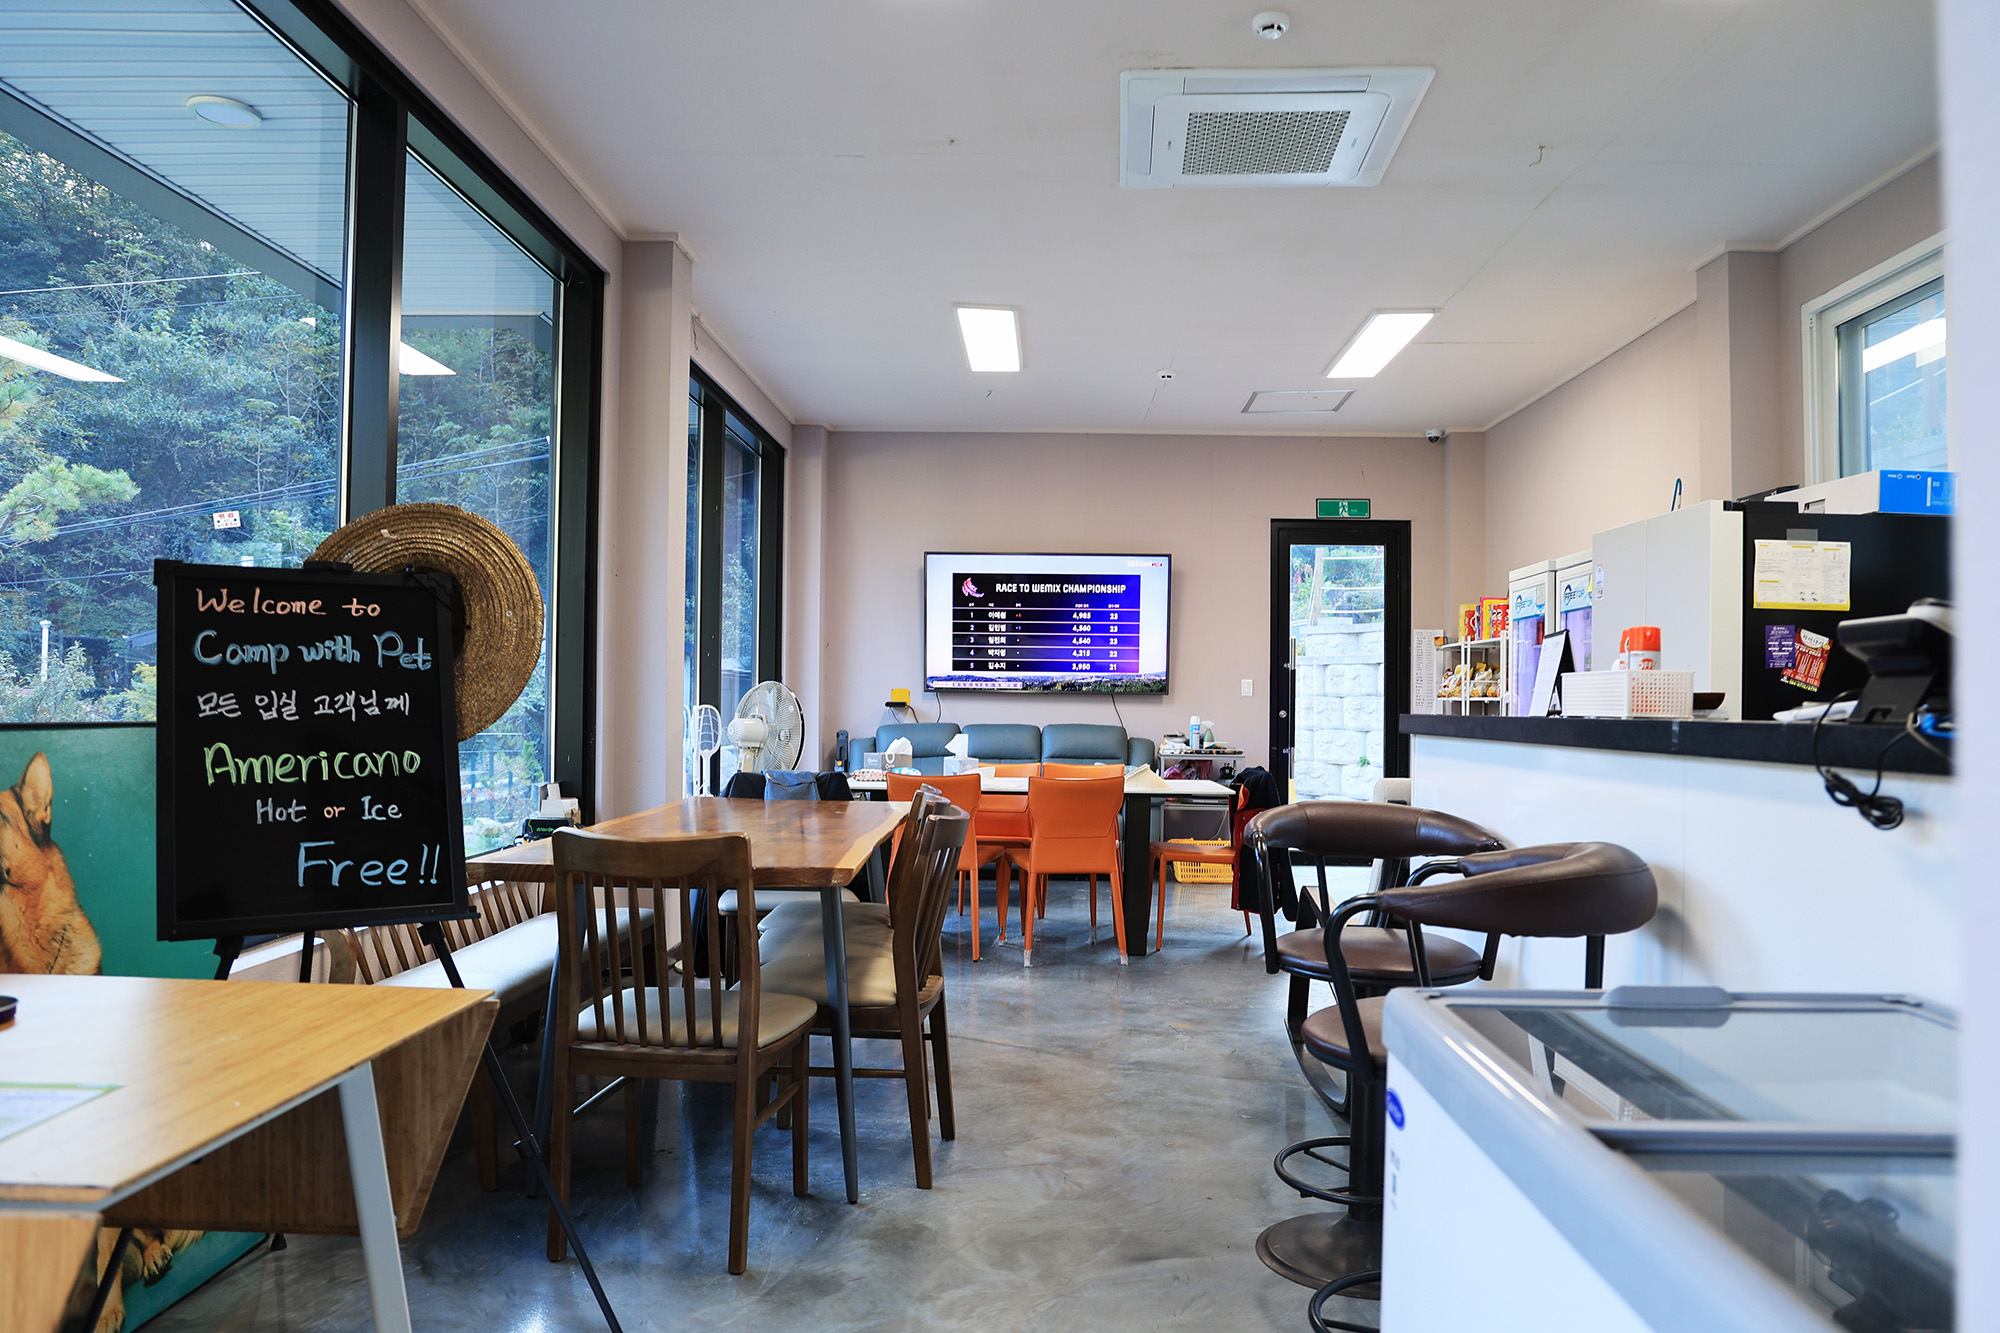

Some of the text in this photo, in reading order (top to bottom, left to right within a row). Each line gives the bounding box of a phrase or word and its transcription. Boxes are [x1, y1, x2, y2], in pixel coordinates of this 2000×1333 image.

[196, 587, 381, 617] Welcome to
[996, 583, 1127, 594] RACE TO WEMIX CHAMPIONSHIP
[194, 630, 432, 675] Camp with Pet
[197, 690, 409, 721] 모든 입실 고객님께
[204, 742, 421, 786] Americano
[256, 795, 402, 824] Hot or Ice
[298, 840, 440, 887] Free!!
